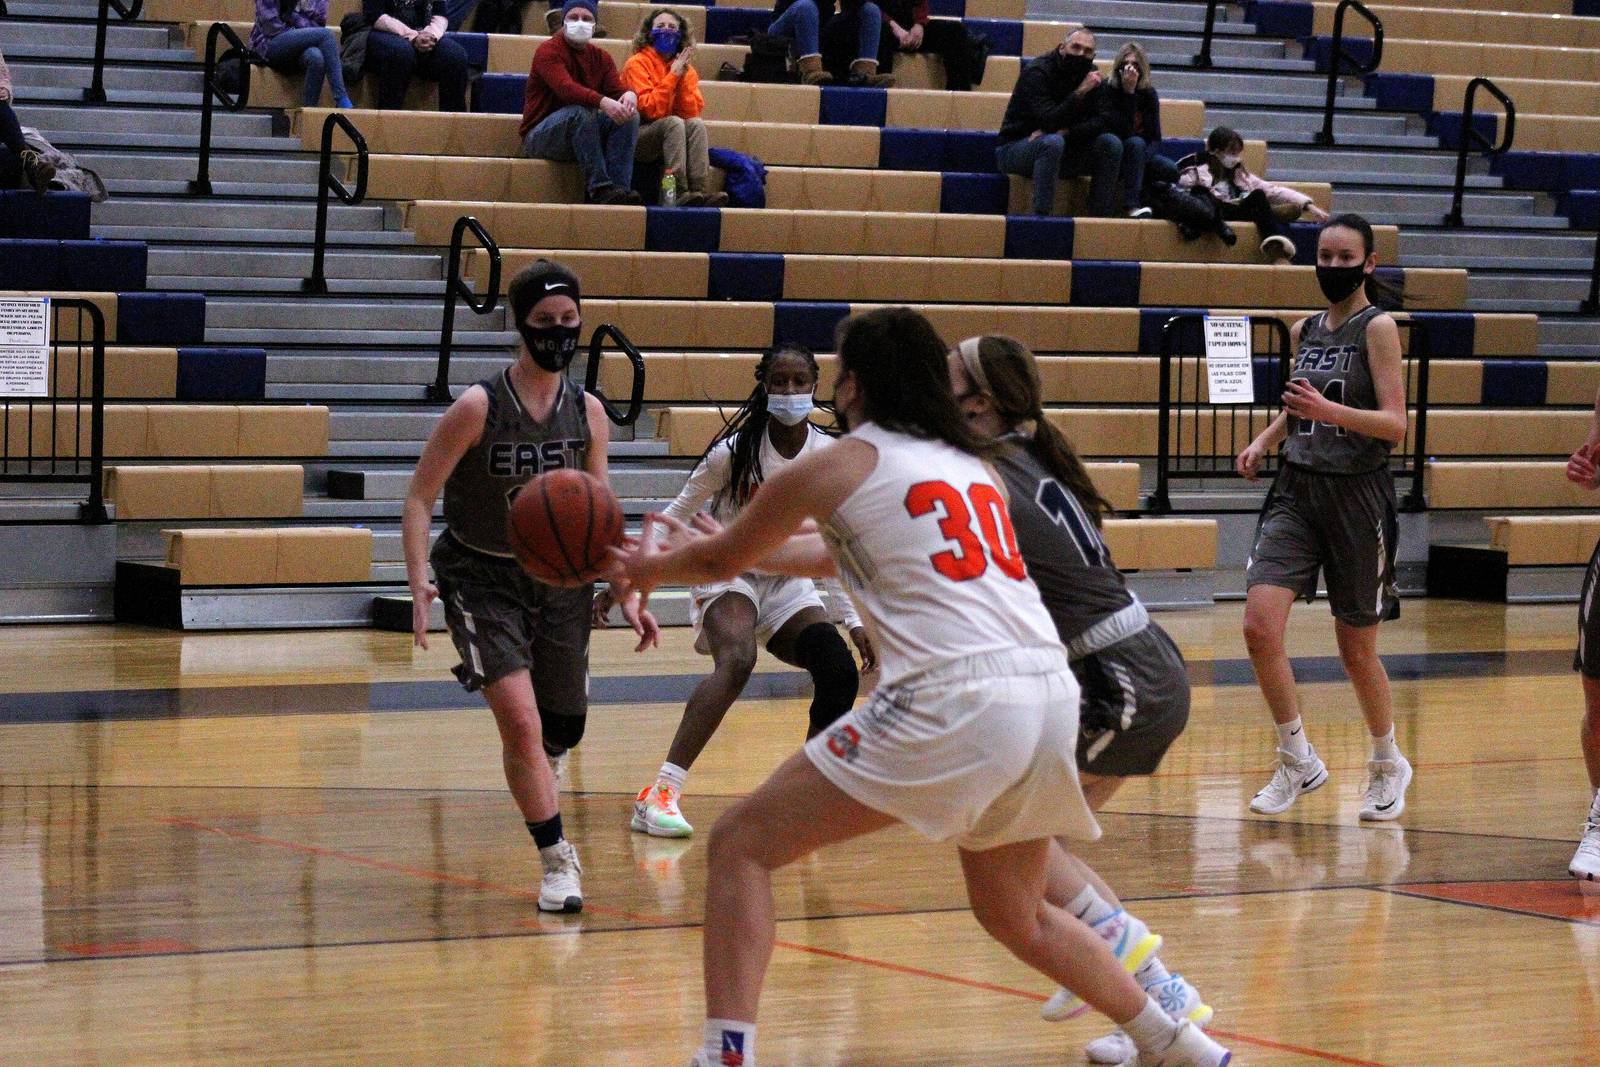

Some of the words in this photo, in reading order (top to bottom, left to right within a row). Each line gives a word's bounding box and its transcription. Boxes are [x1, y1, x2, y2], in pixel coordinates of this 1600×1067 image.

[534, 338, 577, 352] WOES
[1294, 343, 1360, 374] EAST
[488, 438, 586, 477] EAST
[904, 479, 1027, 582] 30
